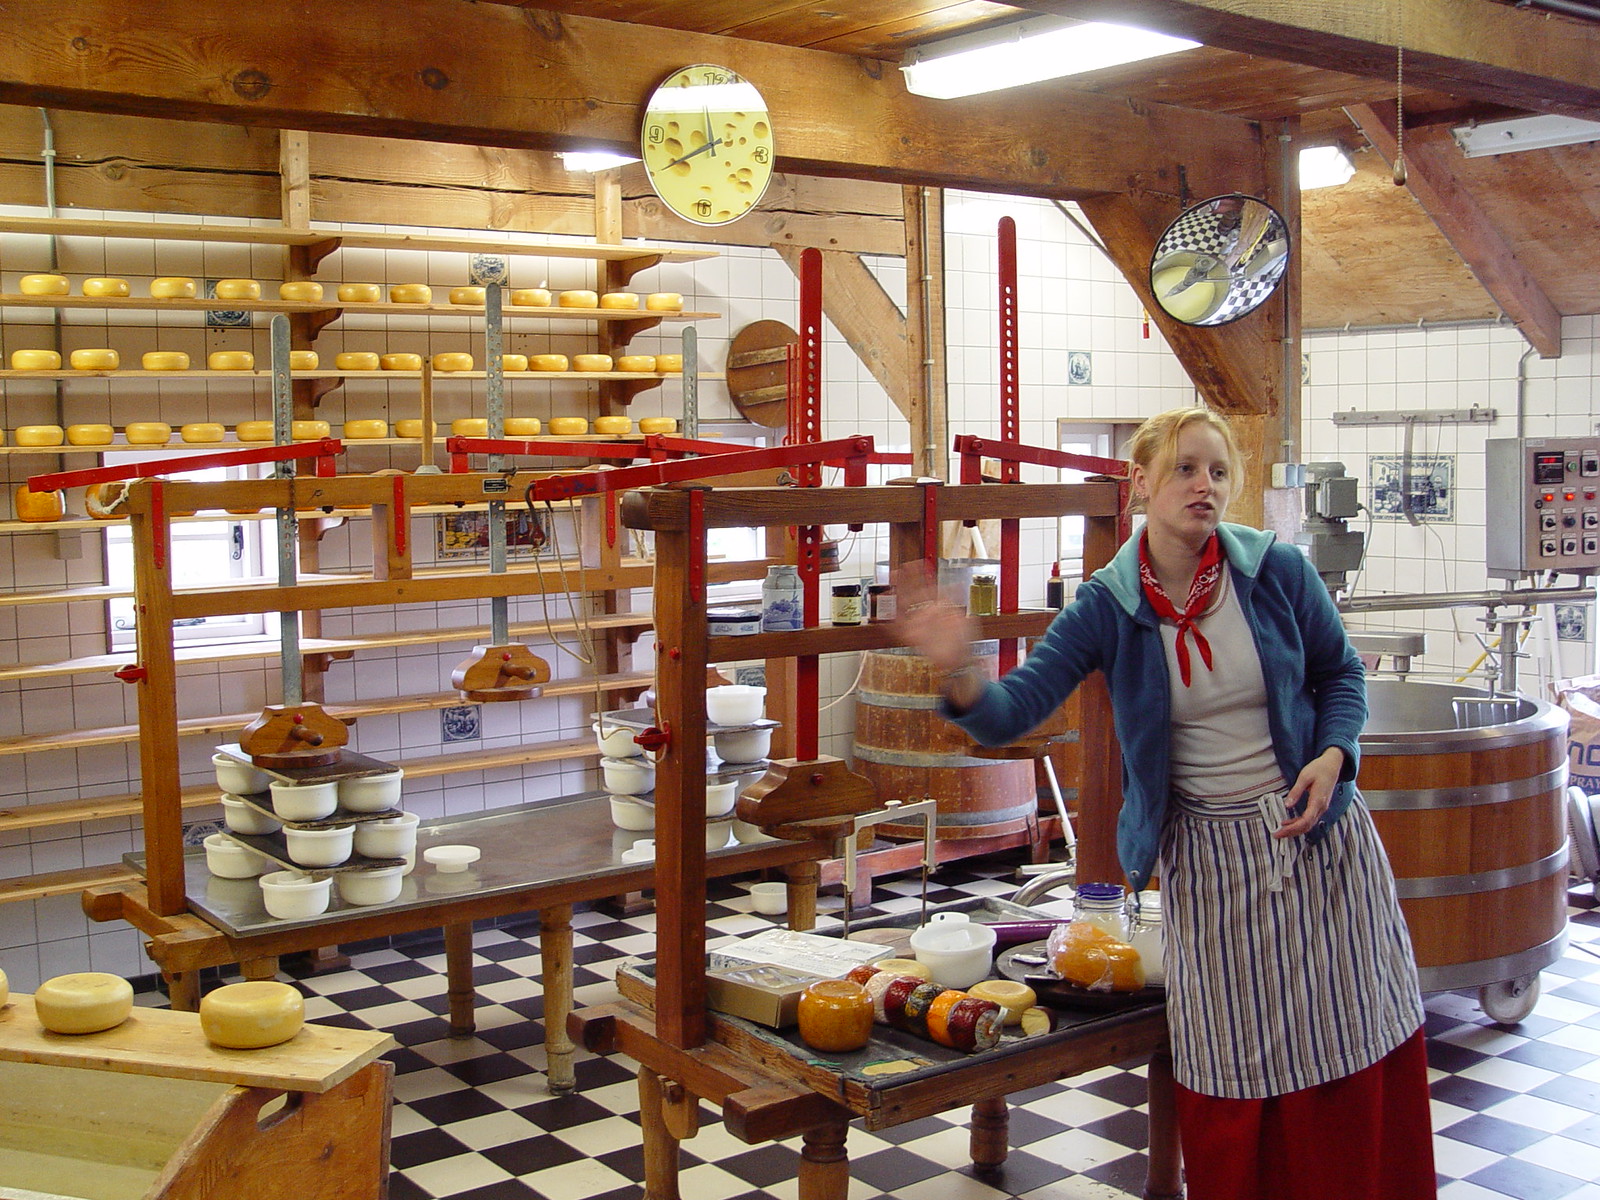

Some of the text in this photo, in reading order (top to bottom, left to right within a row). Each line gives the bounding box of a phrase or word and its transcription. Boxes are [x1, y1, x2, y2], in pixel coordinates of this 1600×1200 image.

[704, 72, 730, 86] 12
[649, 125, 665, 144] 9
[754, 146, 769, 164] 3
[697, 199, 712, 217] 6
